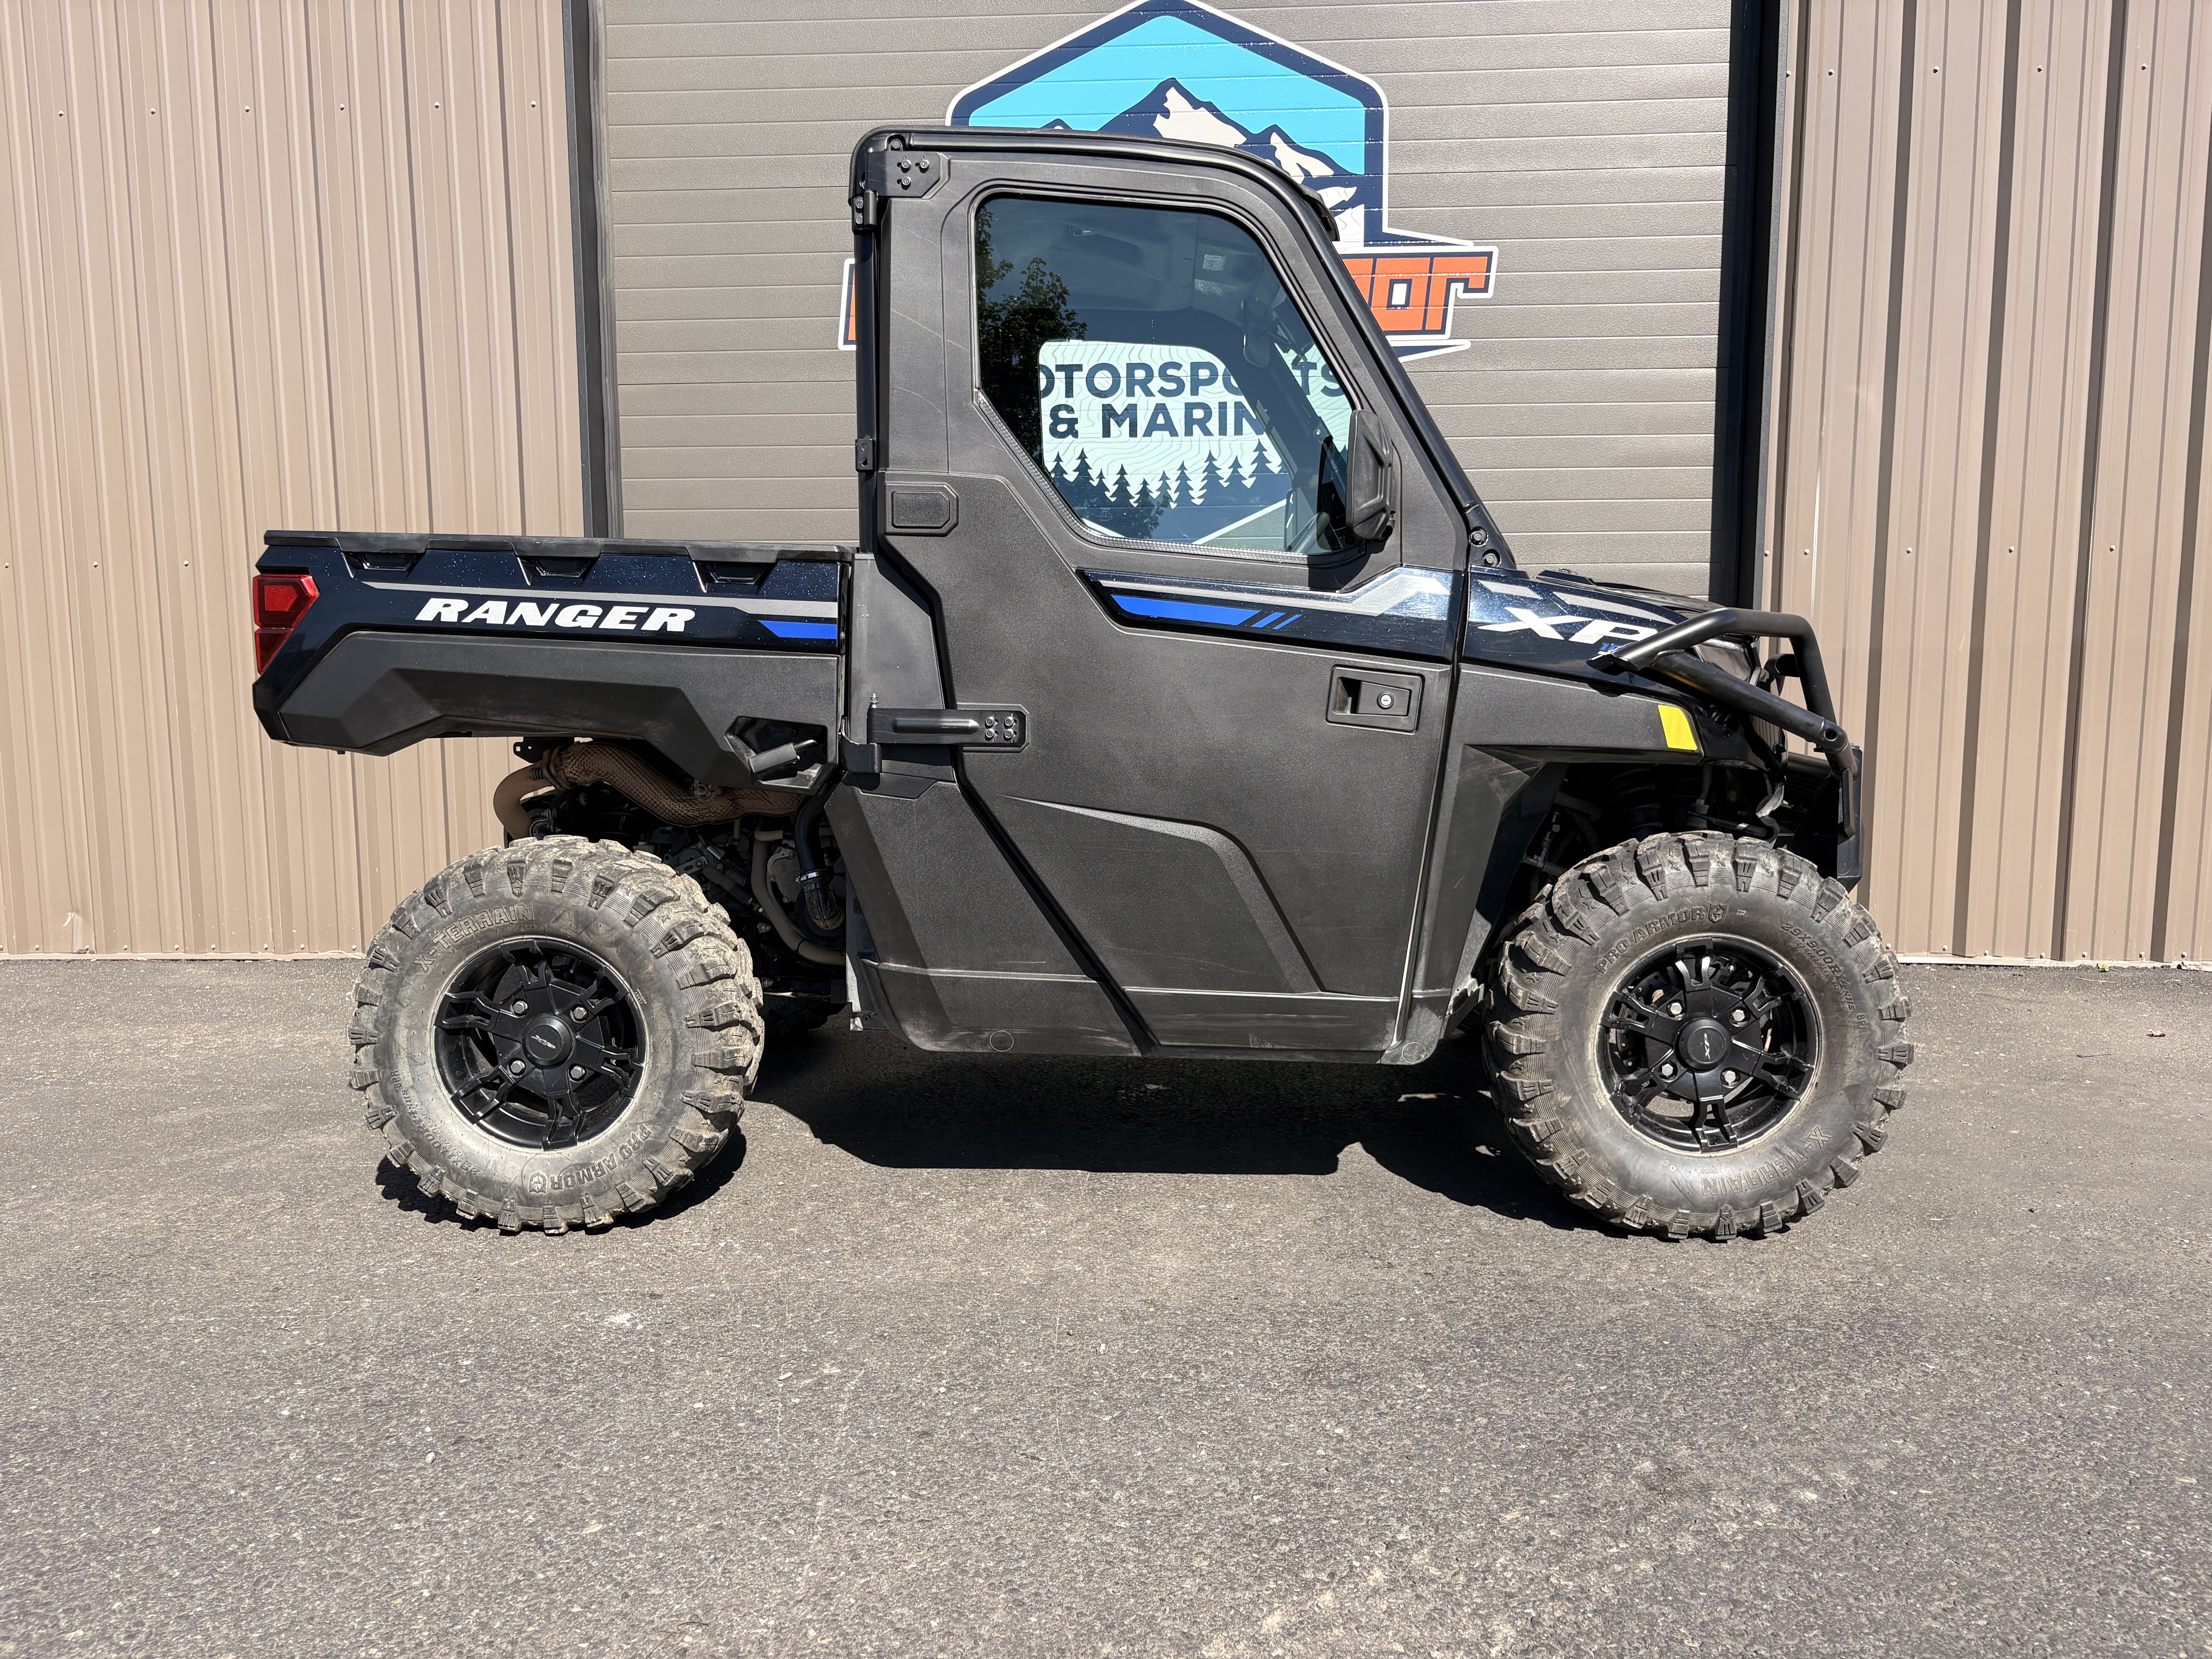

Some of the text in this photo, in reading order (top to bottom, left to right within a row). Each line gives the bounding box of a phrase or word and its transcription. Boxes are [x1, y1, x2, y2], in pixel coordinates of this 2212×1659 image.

[1049, 404, 1079, 439] &
[415, 598, 696, 632] RANGER
[1477, 607, 1658, 644] XP
[412, 903, 535, 973] X-TERRAIN
[1594, 906, 1705, 974] PRO ARMOR
[1704, 1033, 1710, 1060] XP
[550, 1124, 652, 1190] PRO ARMOR
[1702, 1125, 1832, 1196] X-TERRAIN
